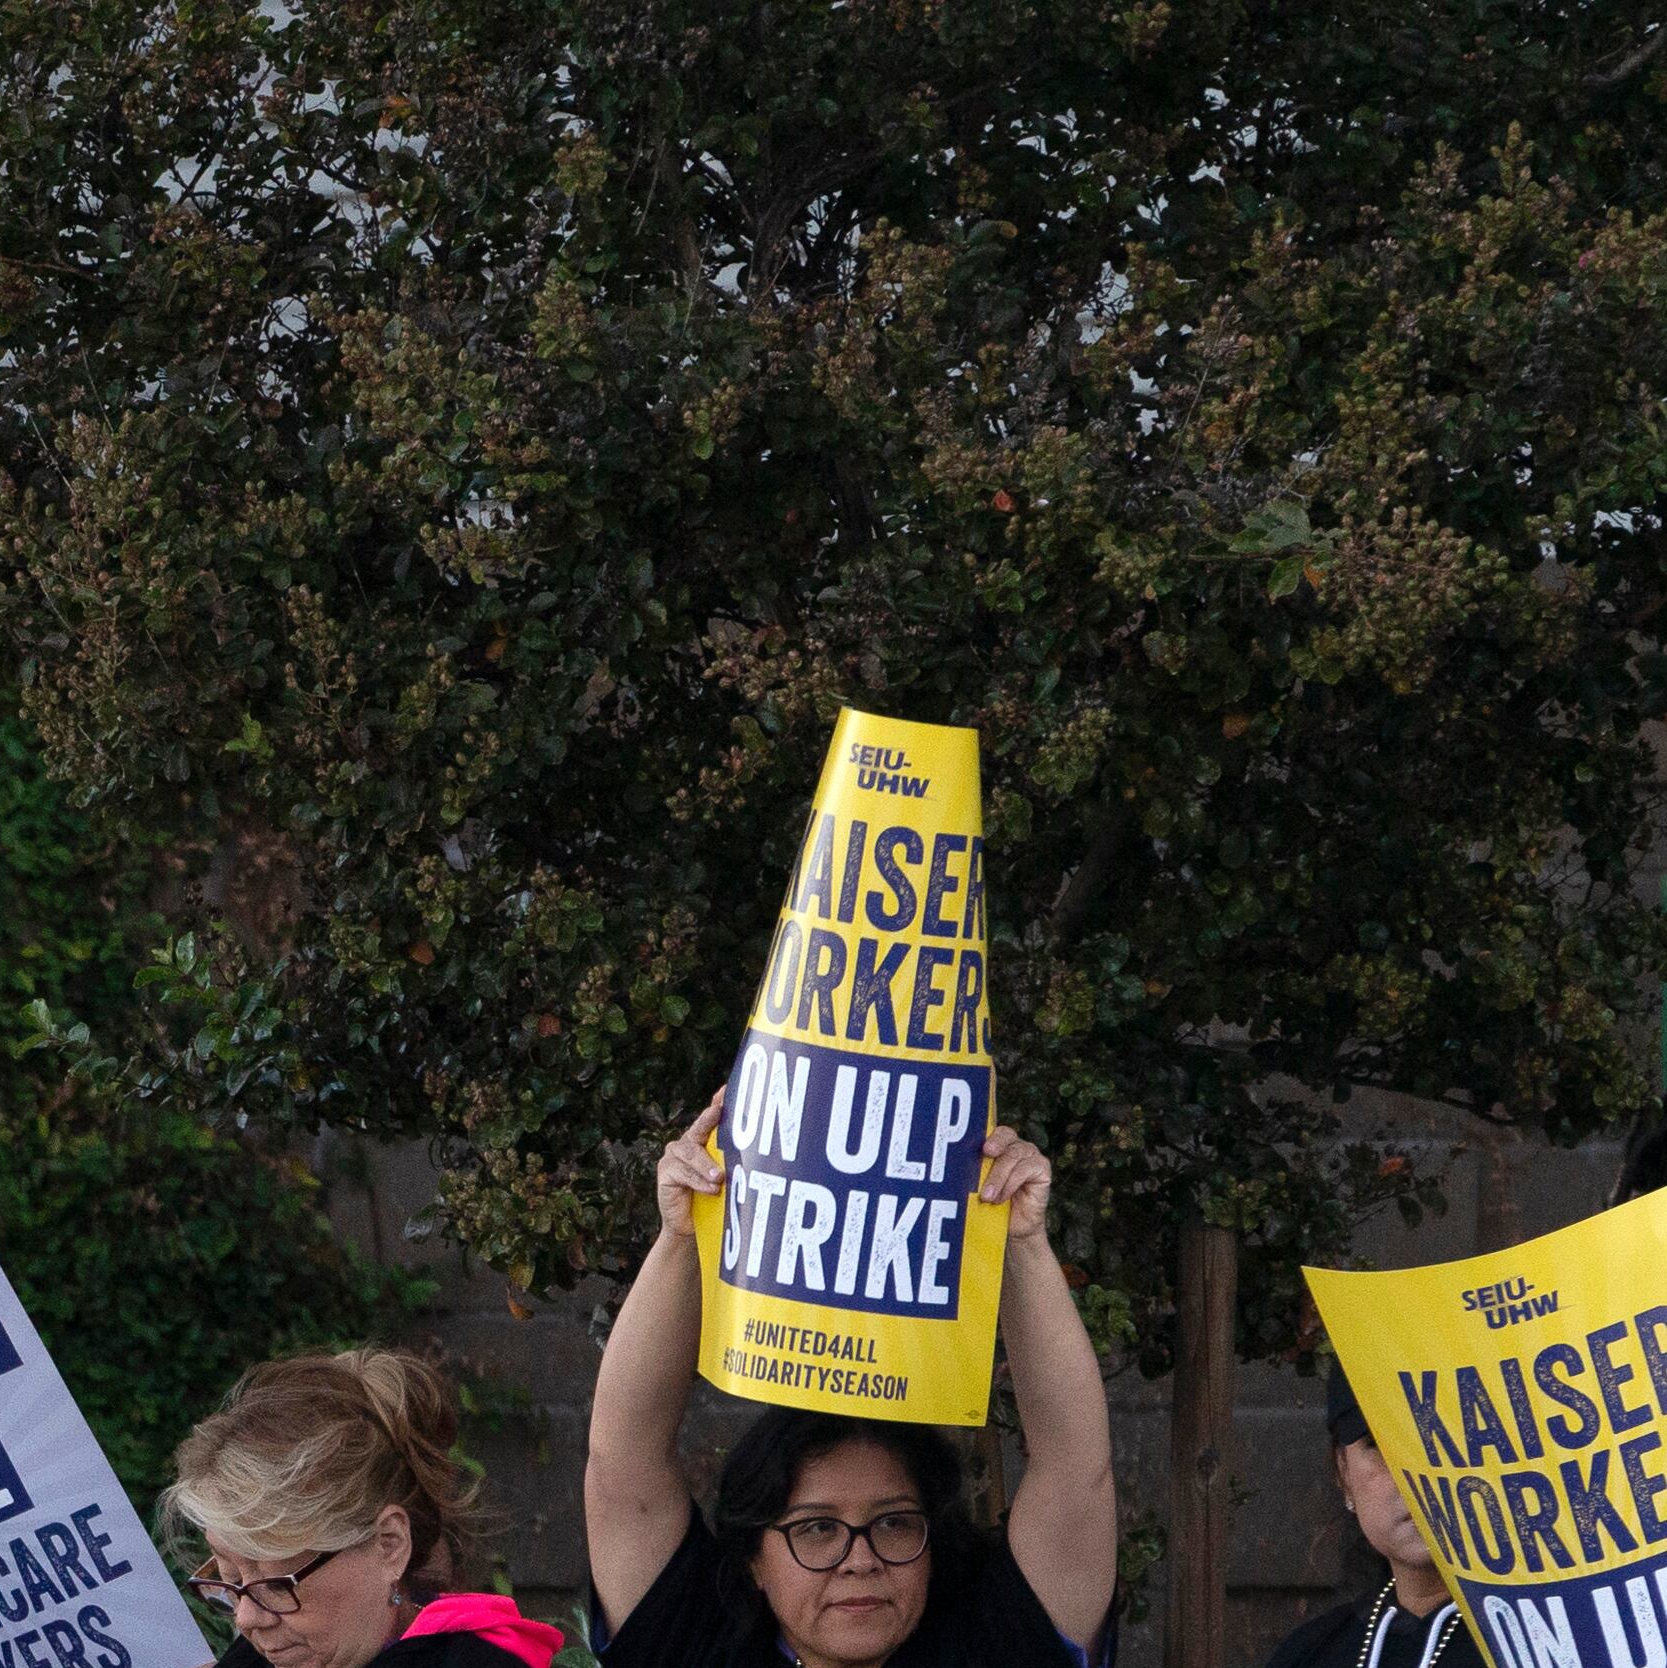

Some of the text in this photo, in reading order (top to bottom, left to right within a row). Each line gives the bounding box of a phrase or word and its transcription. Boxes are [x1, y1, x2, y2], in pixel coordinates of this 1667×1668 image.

[849, 743, 912, 772] SEIU-
[857, 768, 930, 799] UHW
[752, 919, 993, 1057] ORKER
[731, 1043, 971, 1182] ON ULP
[724, 1163, 958, 1304] STRIKE
[1462, 1279, 1536, 1312] SEIU-
[1484, 1290, 1559, 1330] UHW
[744, 1319, 877, 1364] #UNITED4ALL
[723, 1347, 908, 1402] #SOLIDARITYSEASON
[1401, 1431, 1667, 1576] WORKE
